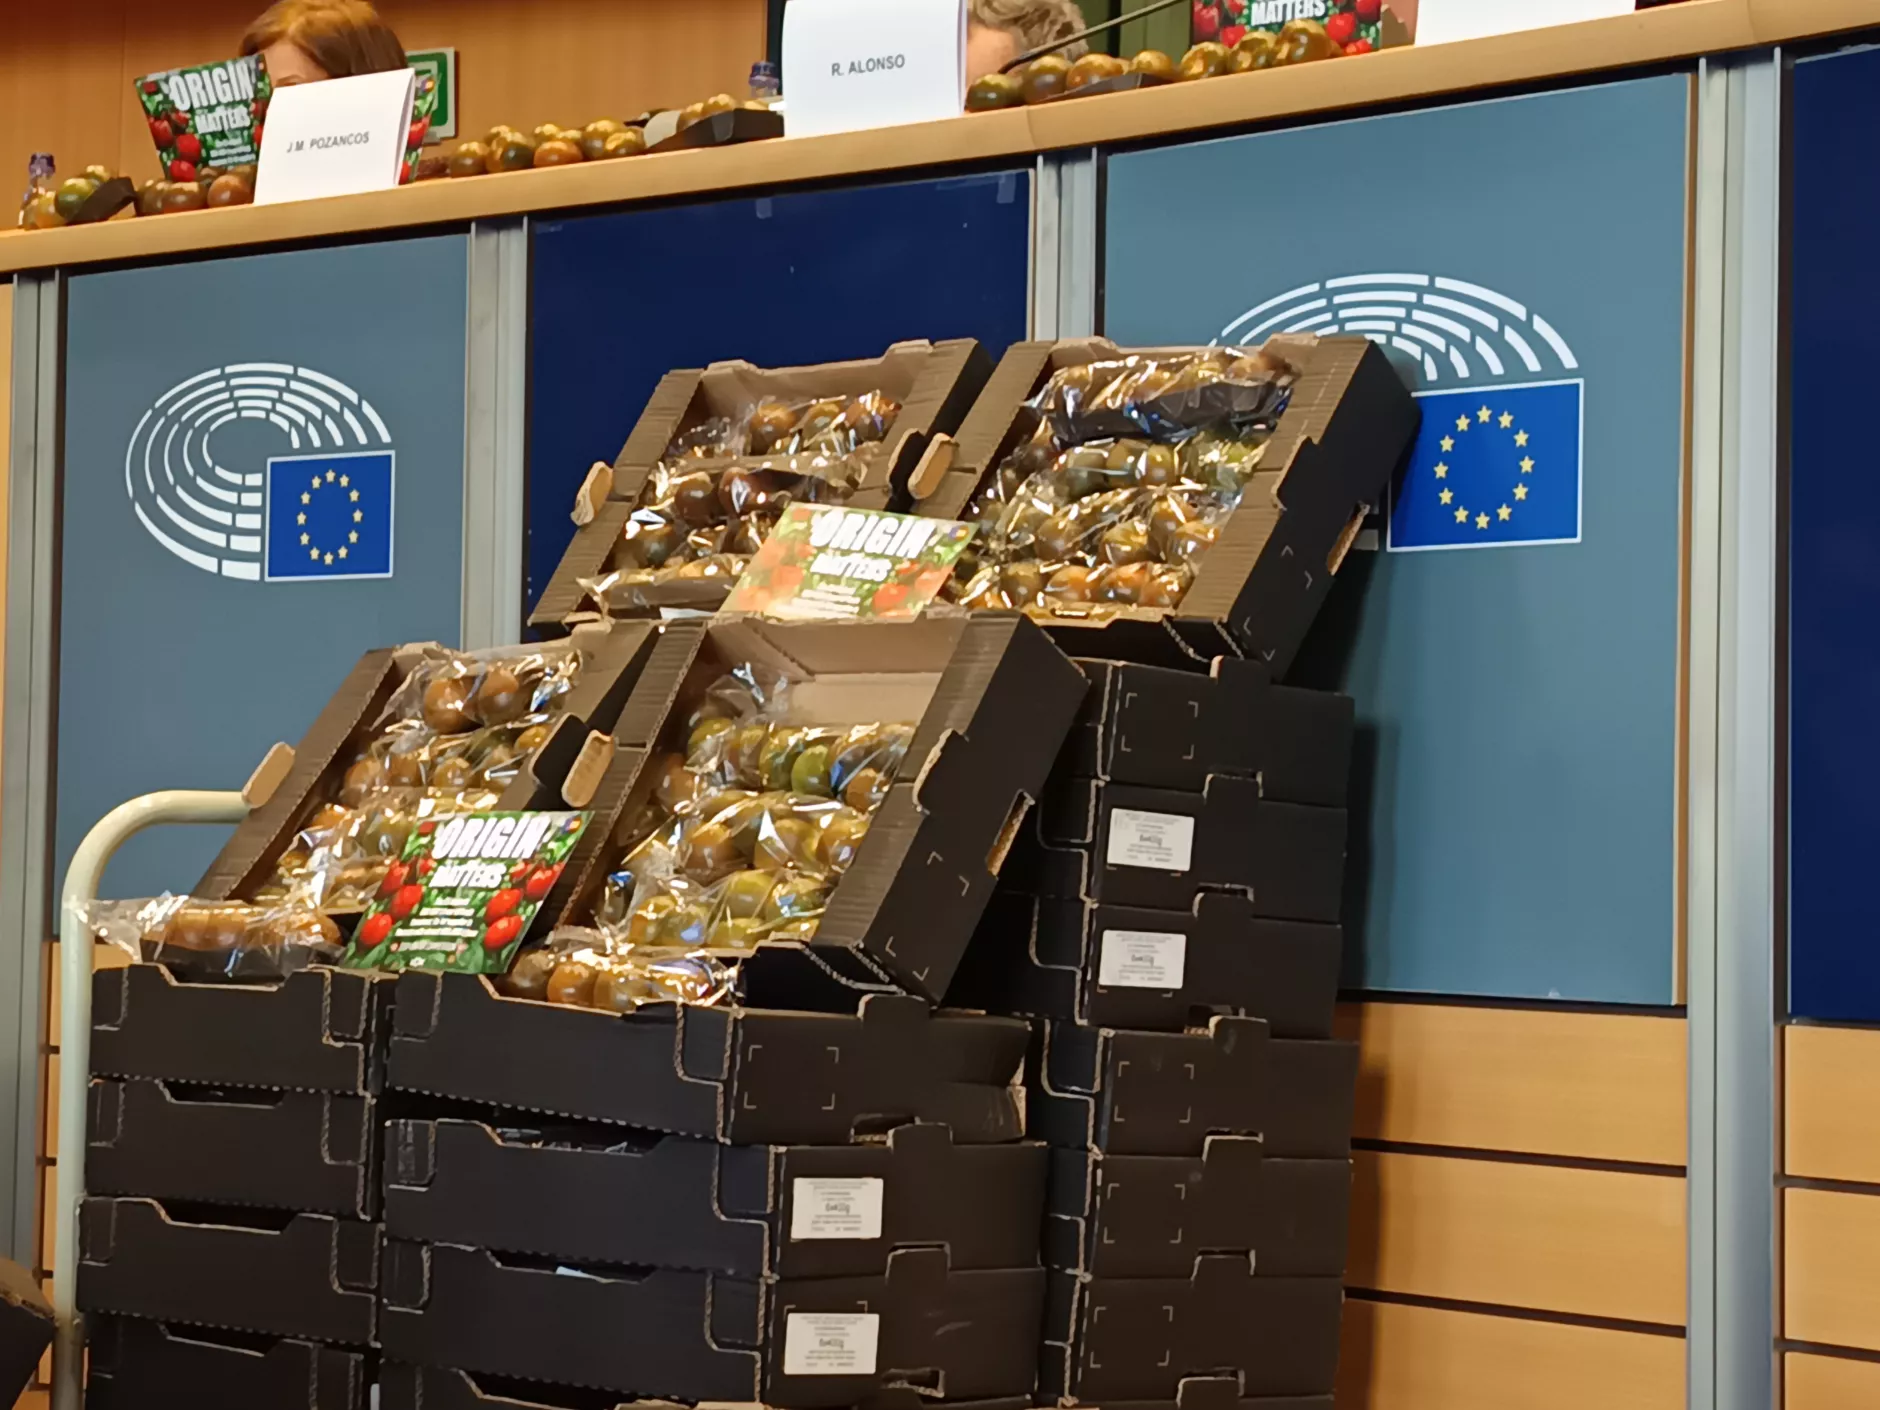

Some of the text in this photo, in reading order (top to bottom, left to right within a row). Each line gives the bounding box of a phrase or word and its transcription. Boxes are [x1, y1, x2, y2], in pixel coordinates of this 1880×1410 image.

[1251, 0, 1325, 25] MATTERS
[831, 53, 905, 76] R. ALONSO
[168, 59, 254, 111] ORIGIN
[195, 106, 251, 134] MATTERS
[309, 130, 370, 150] POZANCOS
[809, 510, 936, 559] ORIGIN
[810, 553, 892, 582] MATTERS
[431, 815, 552, 859] ORIGIN
[429, 861, 507, 889] MATTERS
